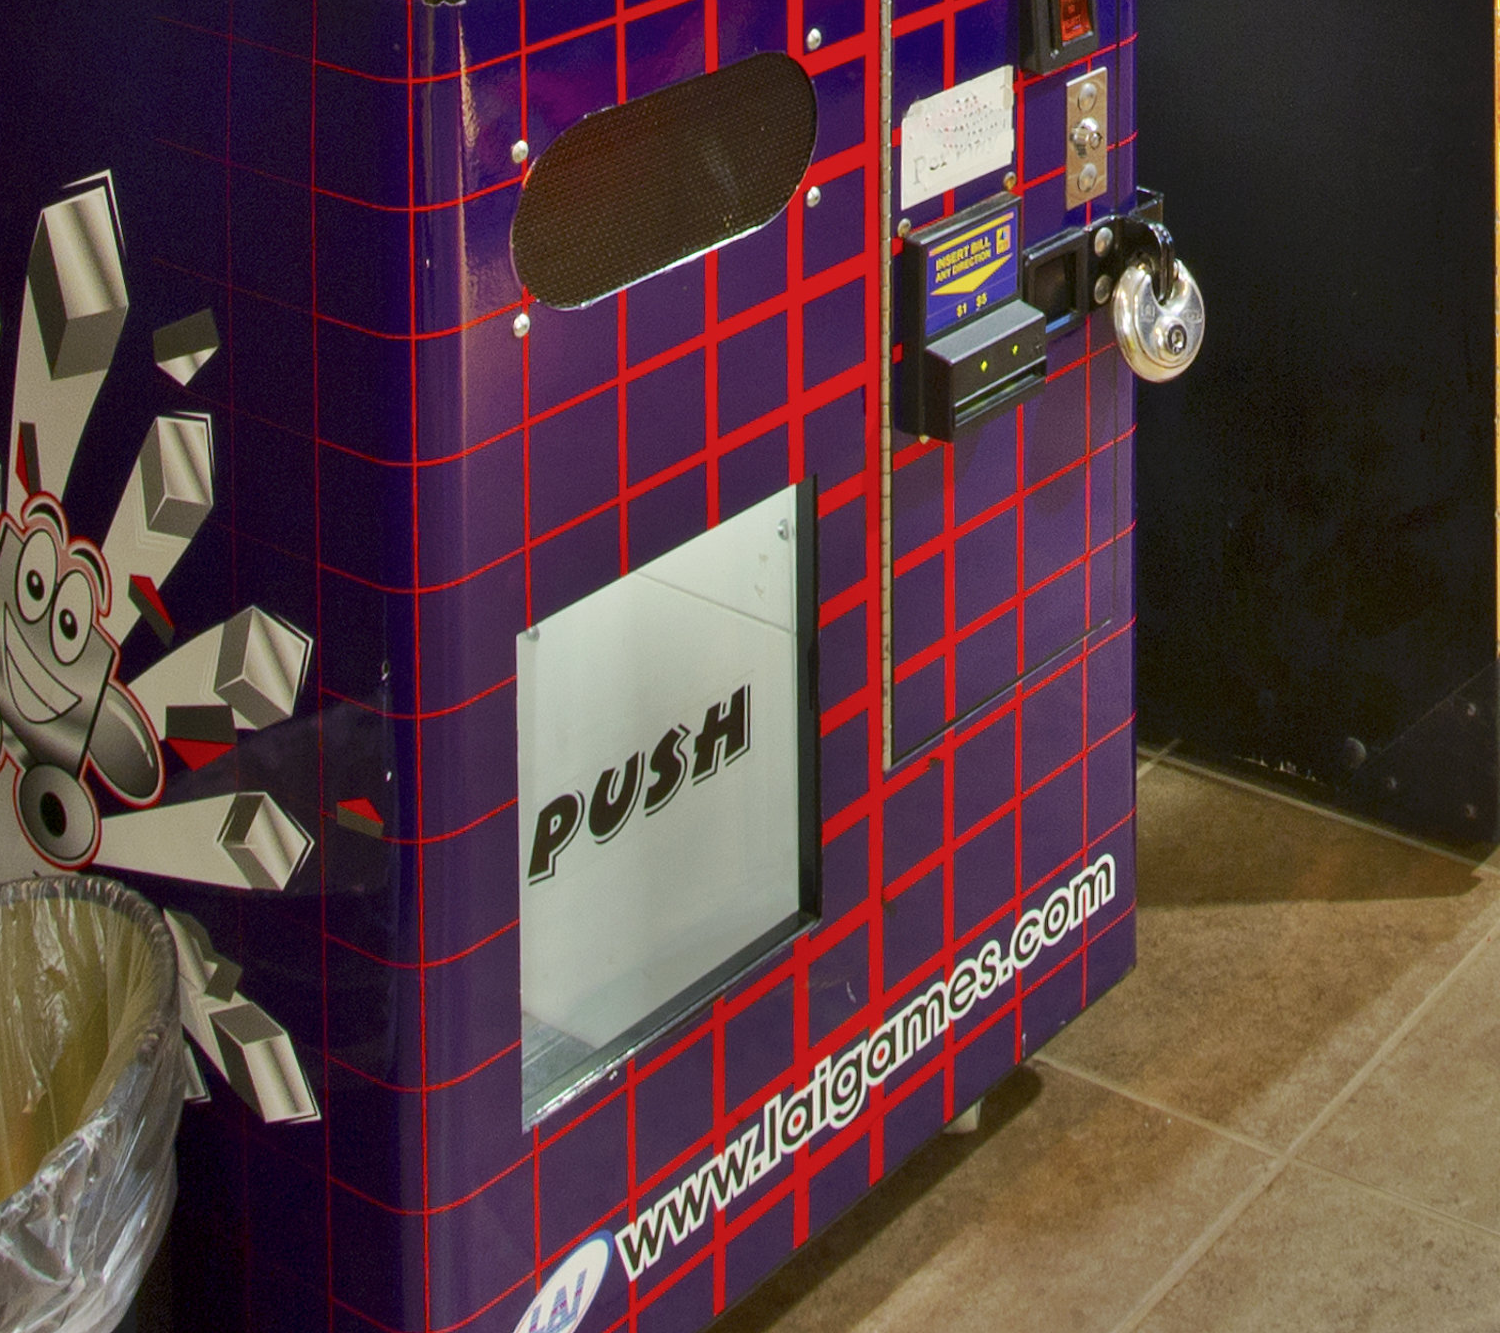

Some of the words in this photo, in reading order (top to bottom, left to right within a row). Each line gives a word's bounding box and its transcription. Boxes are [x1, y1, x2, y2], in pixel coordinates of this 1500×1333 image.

[935, 243, 970, 271] INSERT
[970, 236, 992, 255] BILL
[935, 266, 952, 284] ANY
[952, 248, 992, 276] DIRECTION
[527, 681, 754, 886] PUSH
[614, 852, 1117, 1282] www.laigames.com
